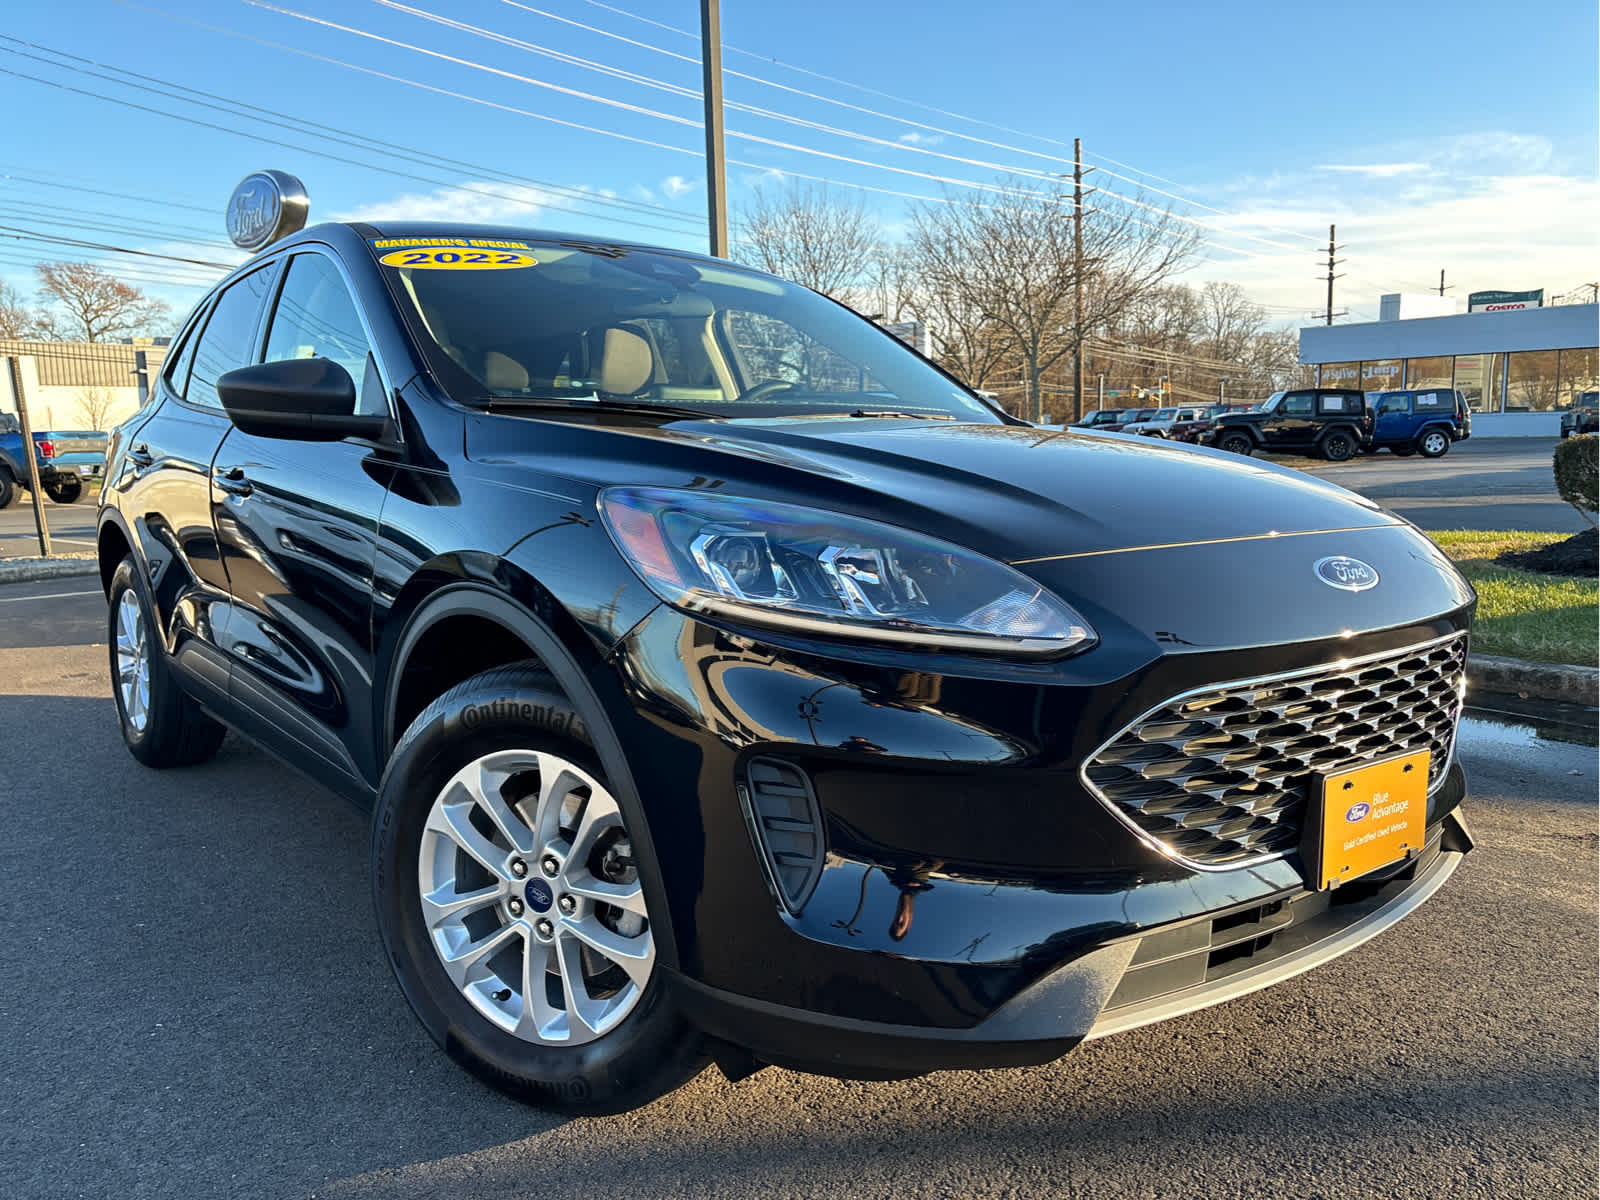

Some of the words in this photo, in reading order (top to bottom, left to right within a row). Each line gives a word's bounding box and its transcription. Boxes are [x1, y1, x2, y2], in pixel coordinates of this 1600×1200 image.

[234, 189, 265, 239] Ford
[374, 239, 468, 248] MANAGER'S
[469, 240, 532, 250] SPECIAL
[403, 252, 522, 265] 2022
[1331, 561, 1369, 581] Ford
[460, 697, 576, 729] Continental
[1373, 792, 1389, 806] Blue
[1348, 804, 1369, 821] Ford
[1373, 800, 1408, 820] Advantage
